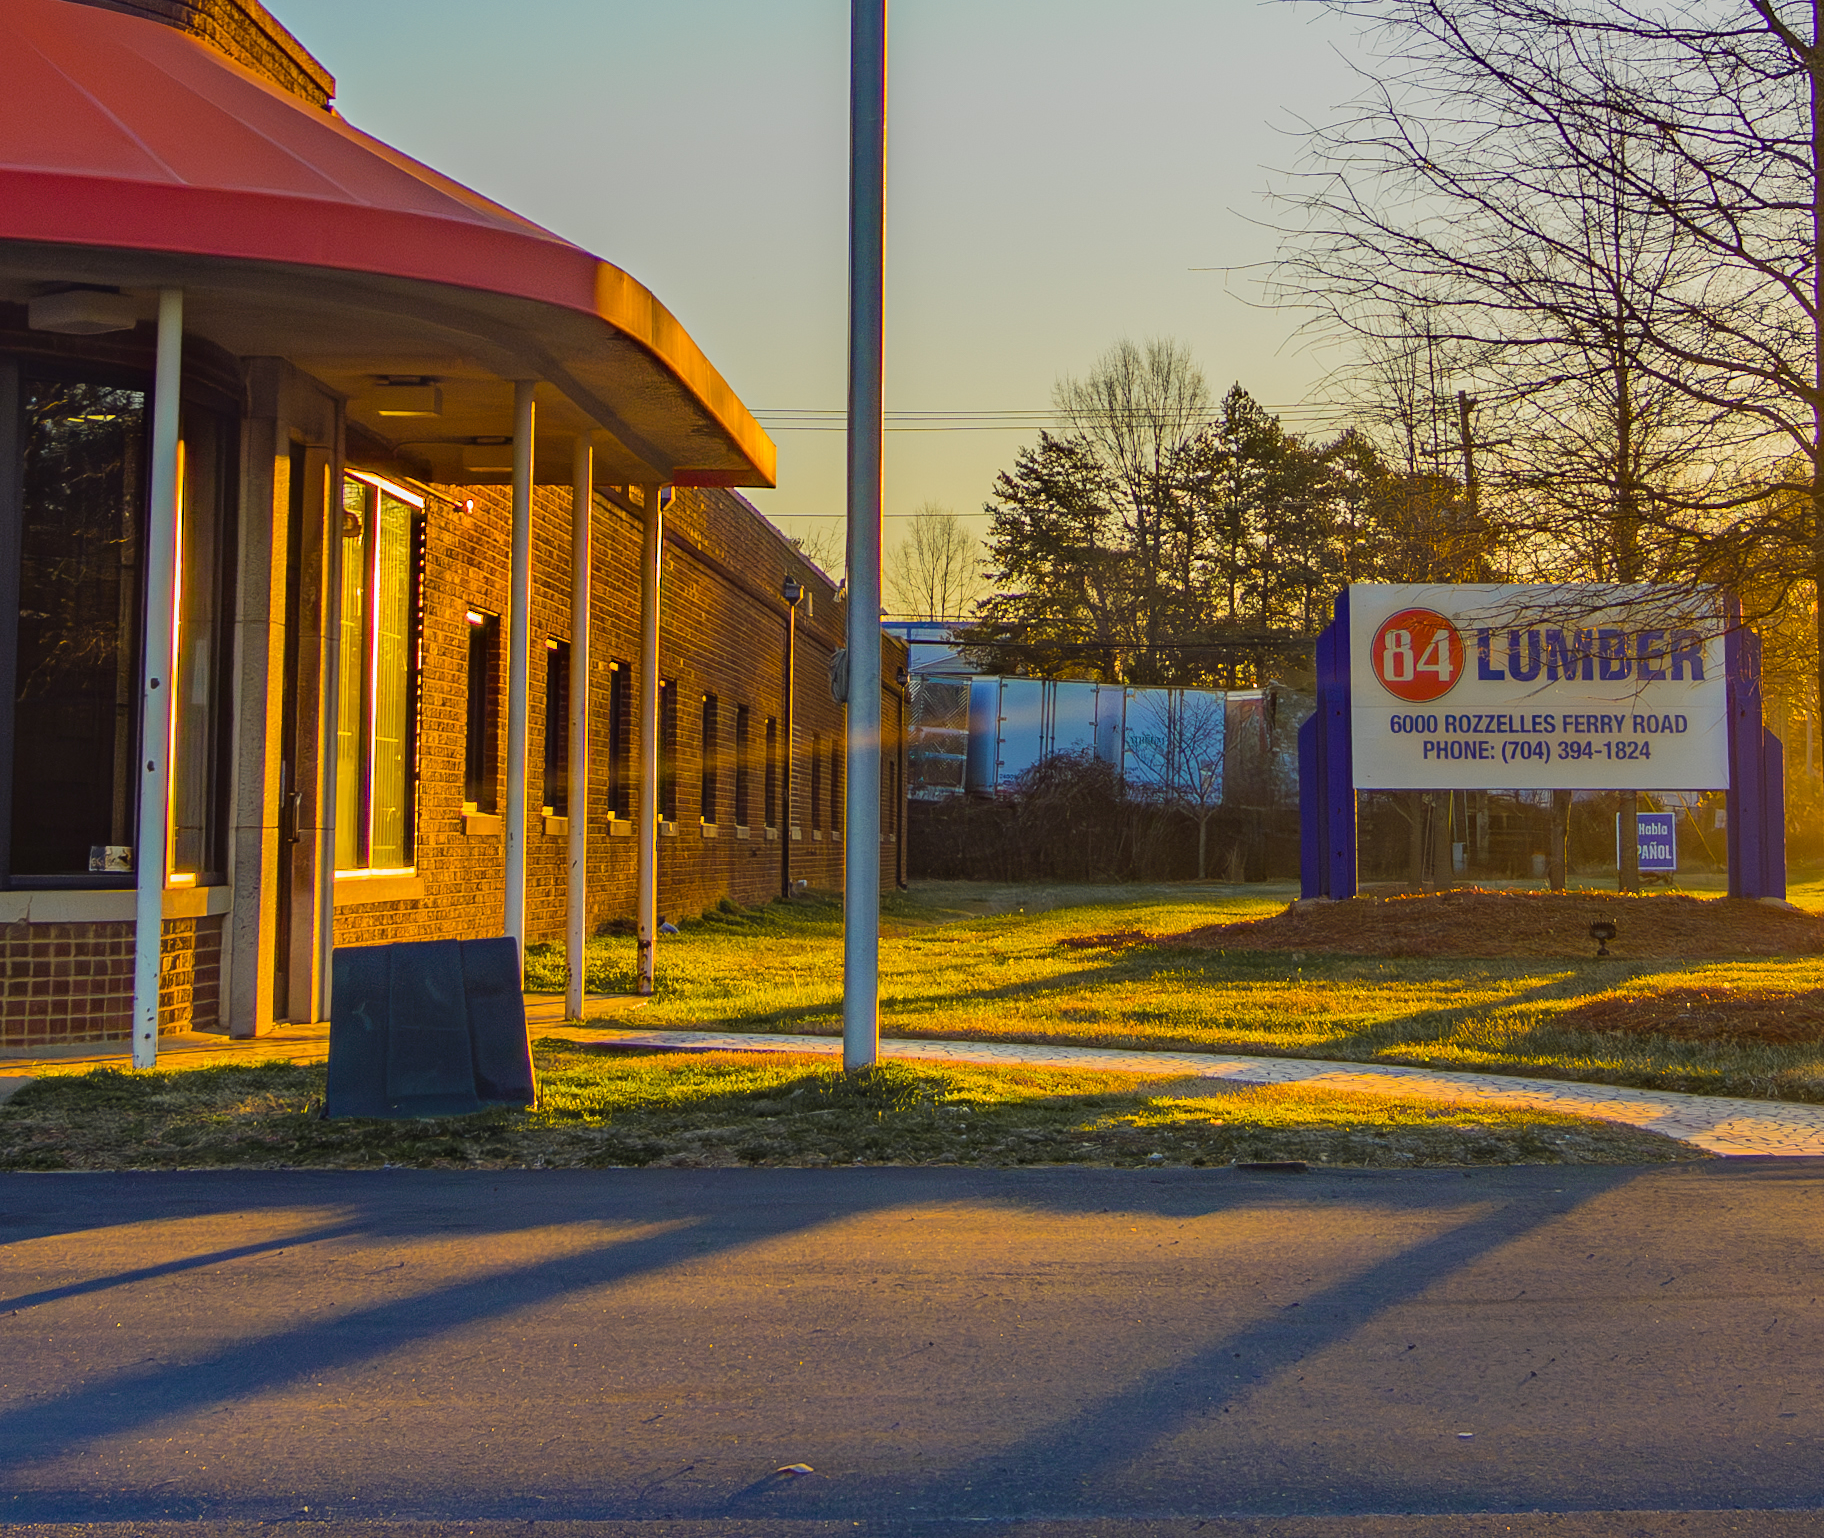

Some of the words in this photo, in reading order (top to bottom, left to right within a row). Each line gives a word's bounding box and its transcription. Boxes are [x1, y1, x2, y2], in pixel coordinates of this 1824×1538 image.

[1383, 629, 1454, 682] 84
[1477, 627, 1705, 682] LUMBER
[1389, 714, 1438, 734] 6000
[1444, 714, 1556, 734] ROZZELLES
[1562, 714, 1626, 734] FERRY
[1632, 714, 1688, 734] ROAD
[1423, 740, 1496, 760] PHONE:
[1501, 739, 1552, 764] (704)
[1557, 740, 1652, 760] 394-1824
[1638, 822, 1668, 836] Habla
